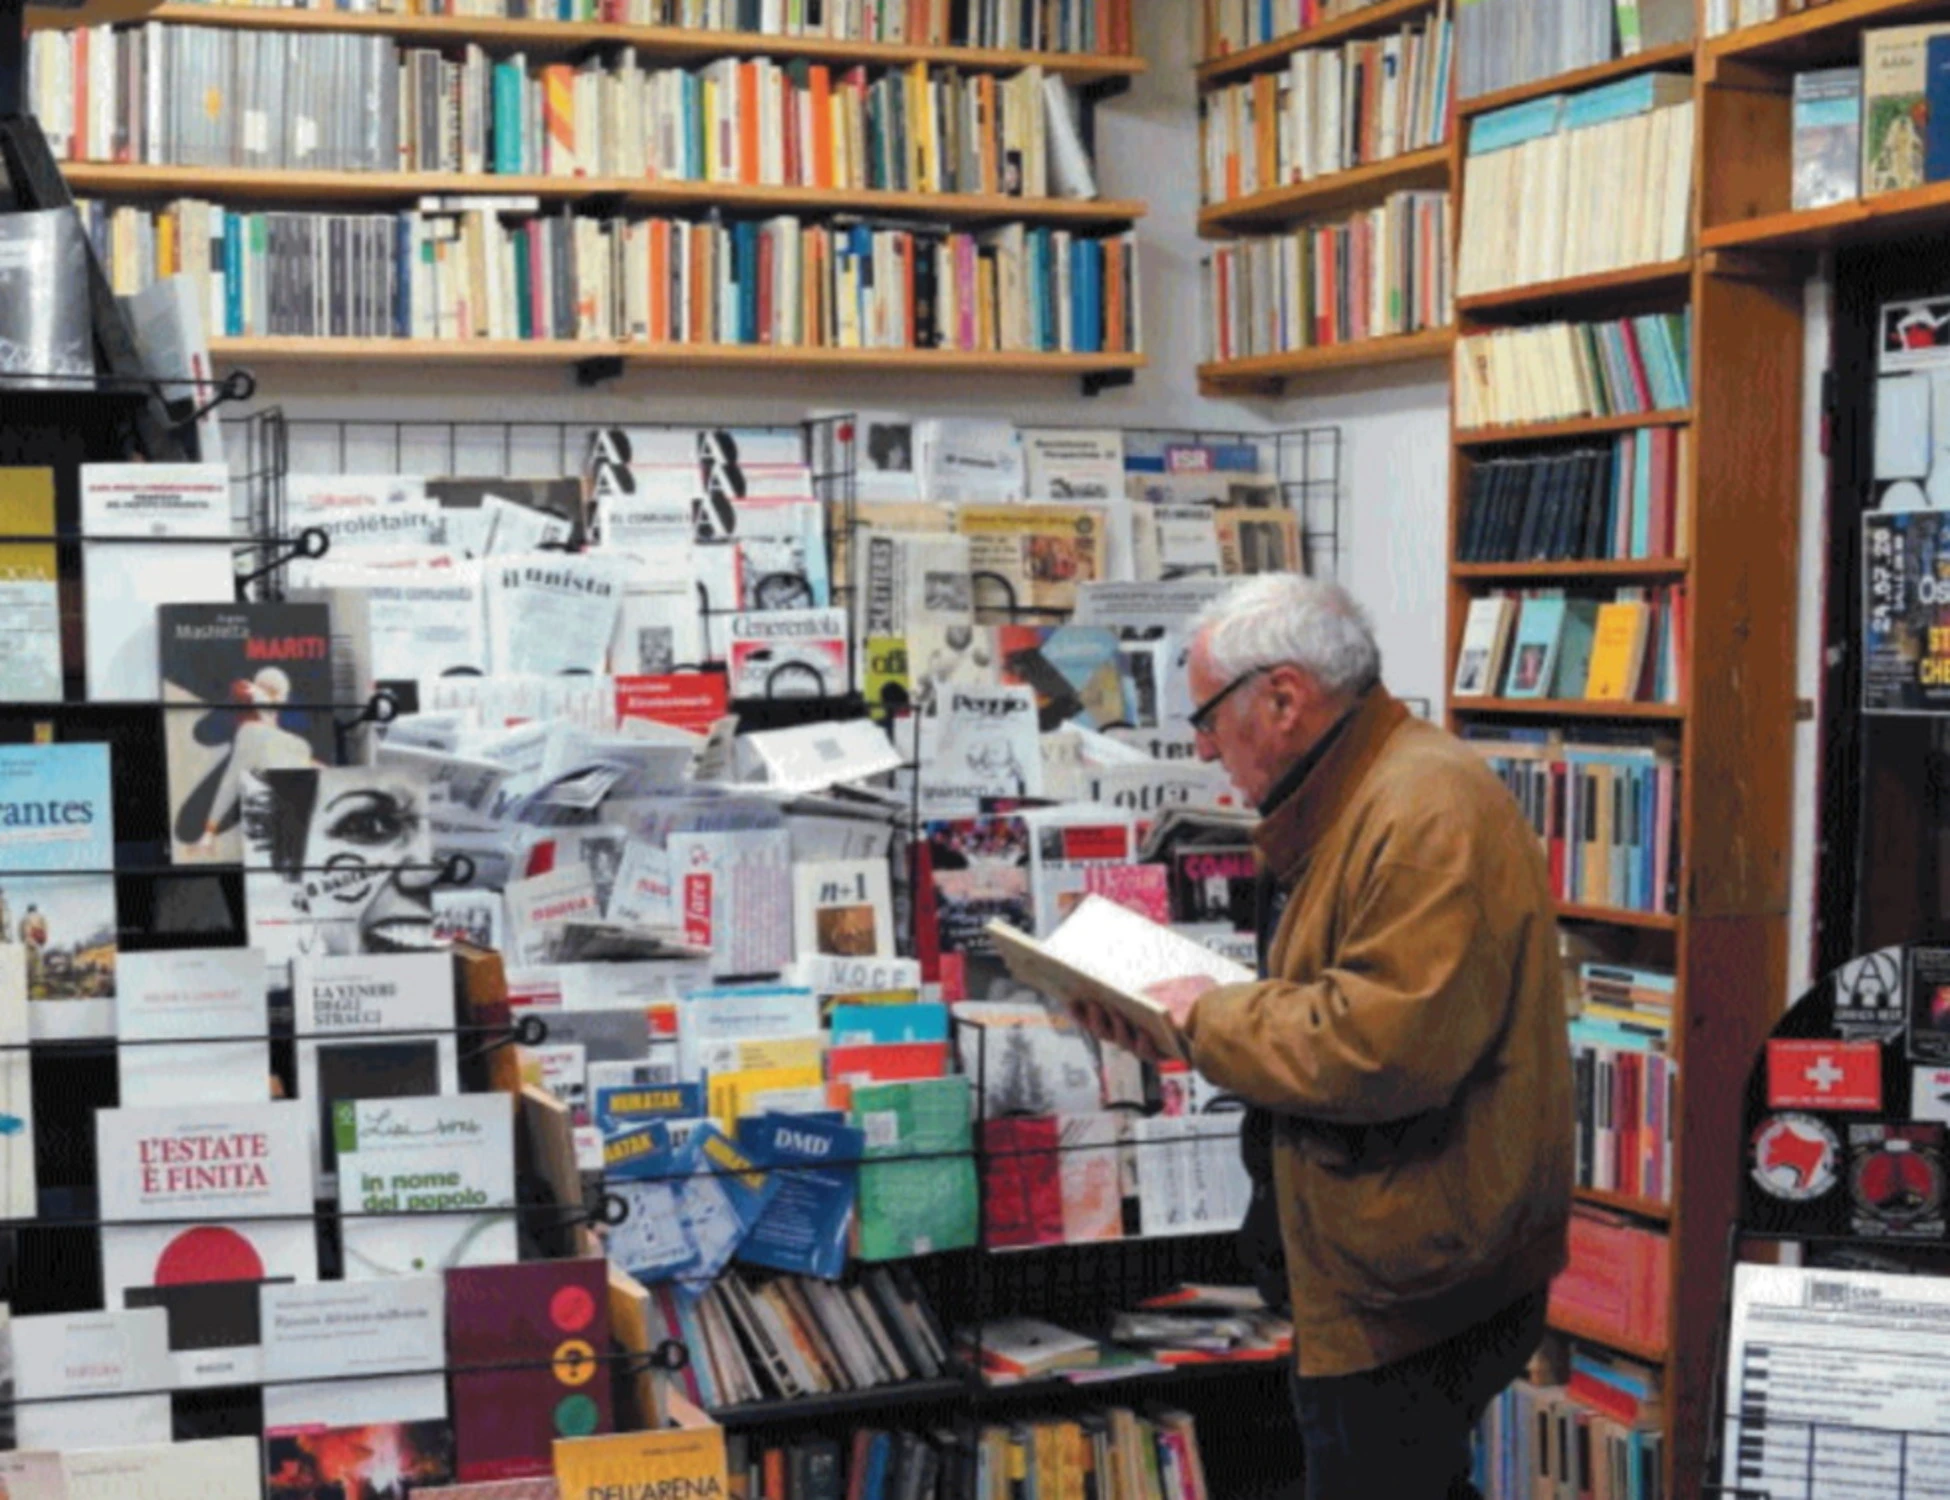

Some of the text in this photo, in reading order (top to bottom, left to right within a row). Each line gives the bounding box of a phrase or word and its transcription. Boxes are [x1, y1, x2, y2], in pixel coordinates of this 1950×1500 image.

[0, 800, 94, 826] antes
[166, 1162, 269, 1193] FINITA
[361, 1171, 461, 1192] in nome
[363, 1186, 488, 1212] del popolo
